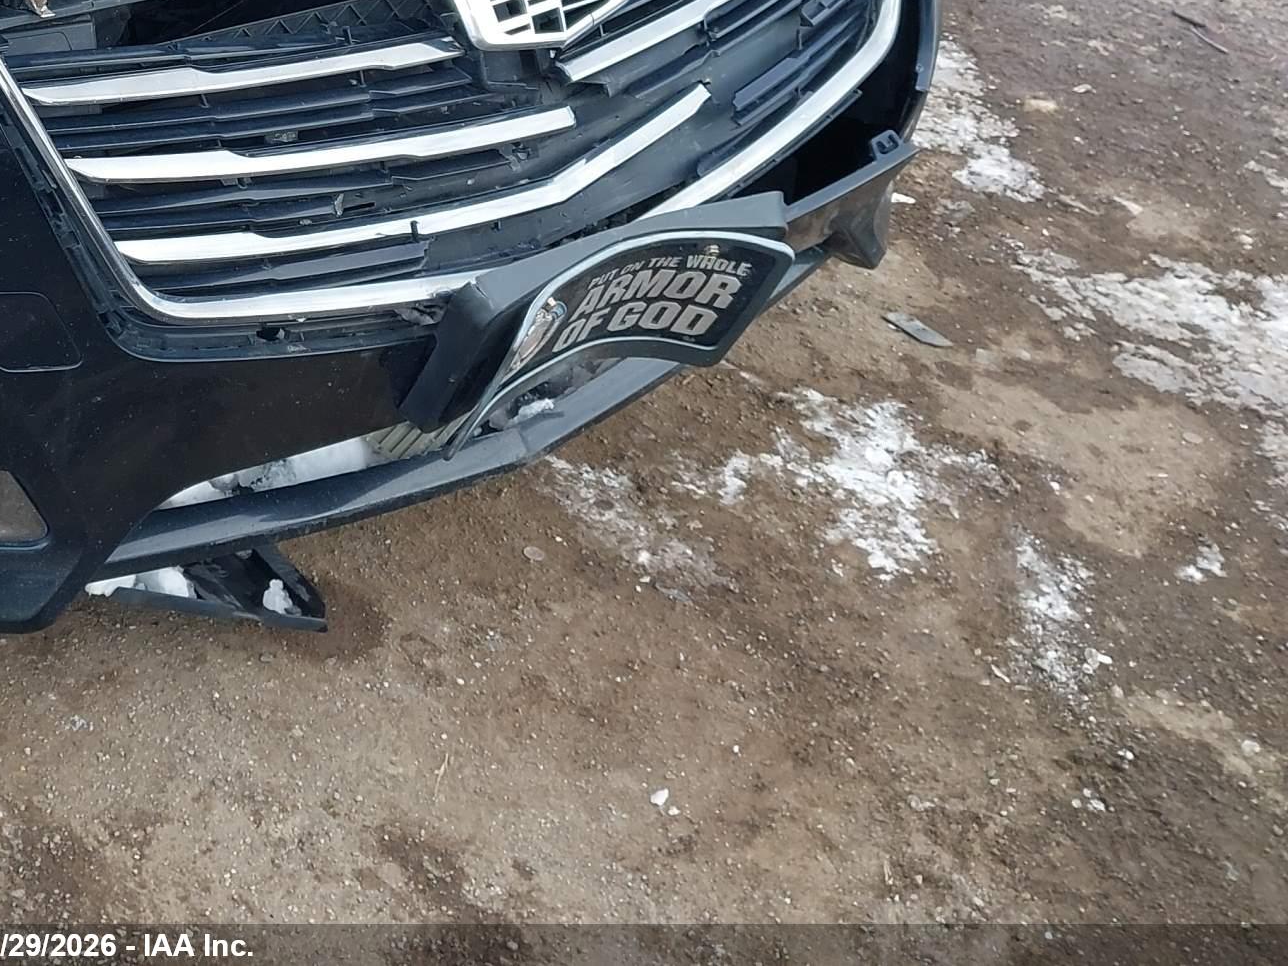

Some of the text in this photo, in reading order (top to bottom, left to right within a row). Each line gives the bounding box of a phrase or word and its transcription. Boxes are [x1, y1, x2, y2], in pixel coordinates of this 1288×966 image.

[569, 269, 743, 321] ARMOR
[588, 254, 752, 289] PUT ON THE WHOLE
[552, 301, 718, 352] OF GOD
